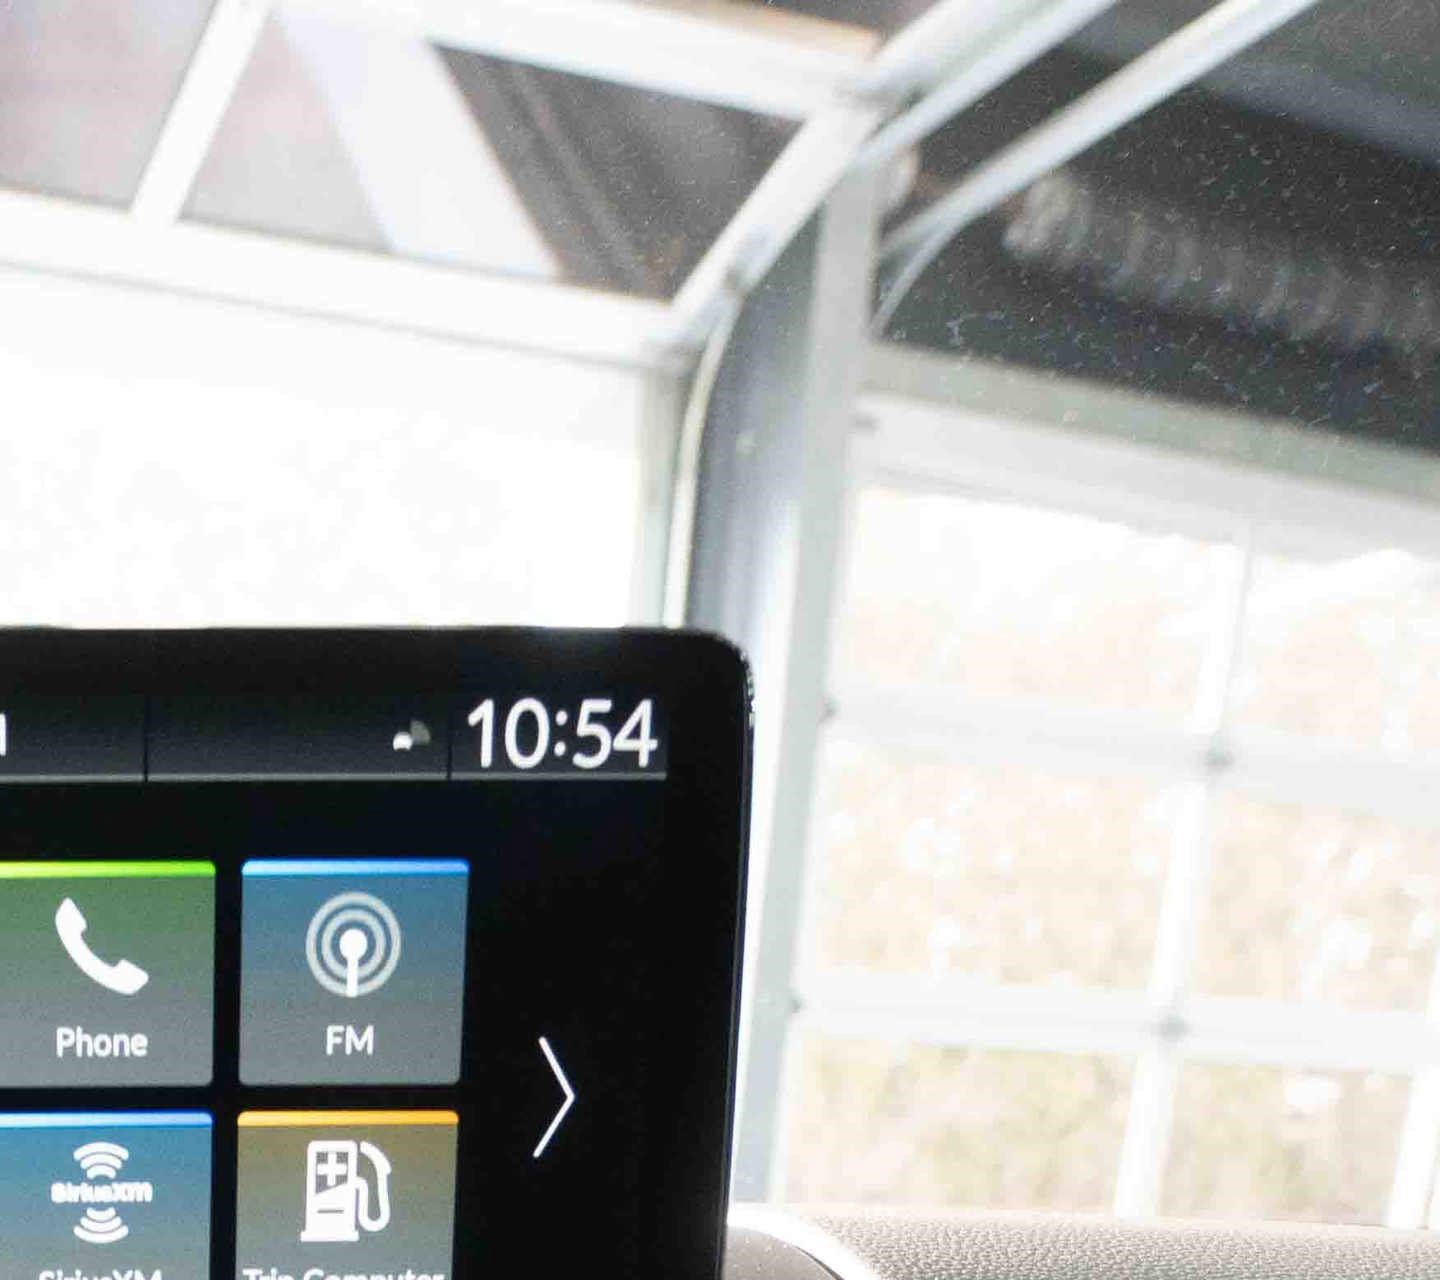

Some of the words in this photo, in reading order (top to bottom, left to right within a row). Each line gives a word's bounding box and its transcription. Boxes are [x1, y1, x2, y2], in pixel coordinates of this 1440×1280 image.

[466, 699, 658, 769] 10:54
[56, 1027, 148, 1057] Phone
[326, 1025, 374, 1055] FM
